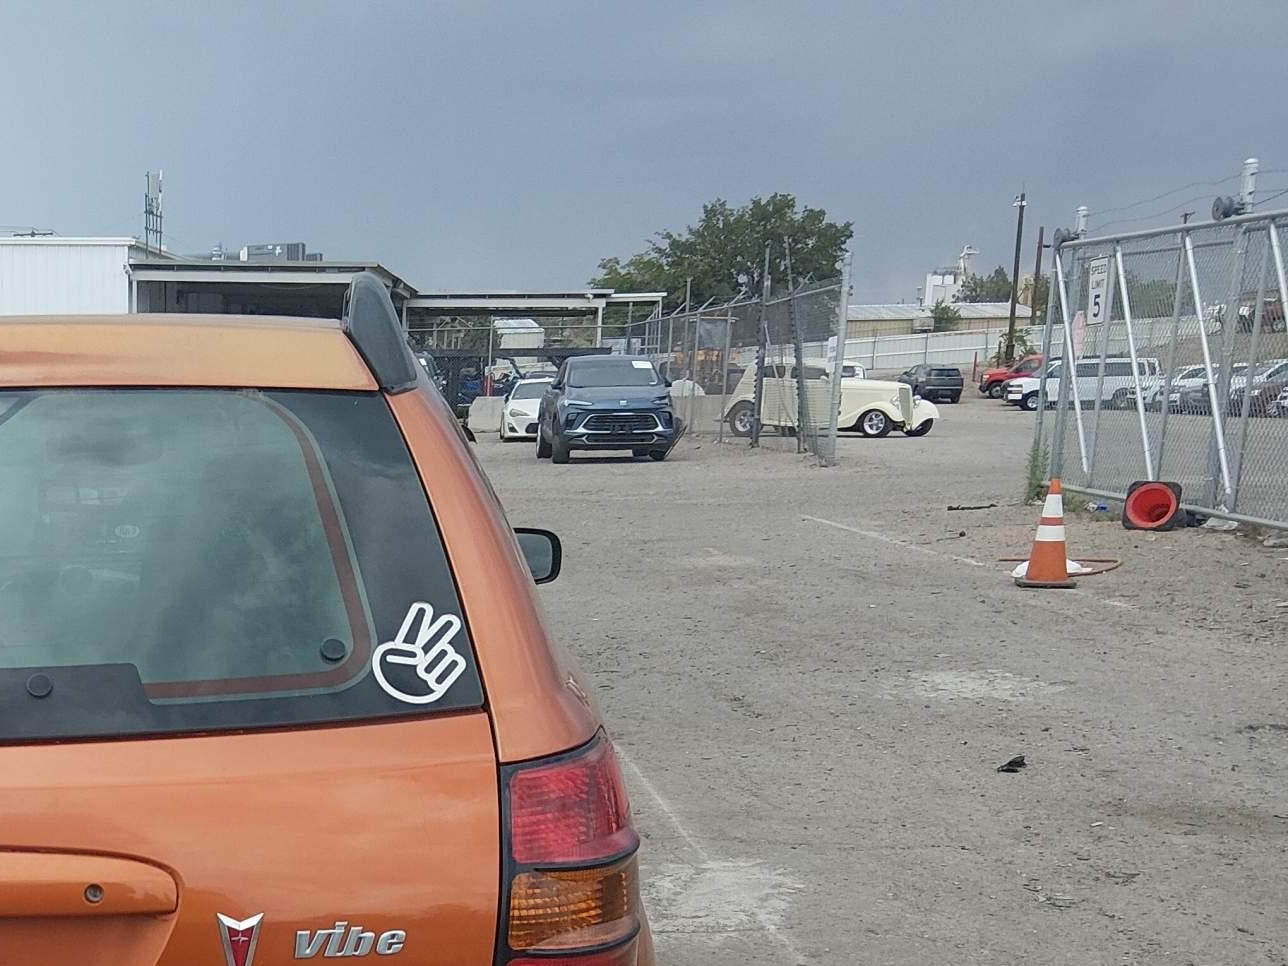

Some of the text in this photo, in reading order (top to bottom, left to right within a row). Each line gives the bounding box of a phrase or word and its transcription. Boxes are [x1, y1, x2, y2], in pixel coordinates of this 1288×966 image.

[1091, 264, 1107, 275] SPEED
[1091, 279, 1105, 290] LIMIT
[1093, 294, 1101, 318] 5
[294, 921, 407, 959] vibe
